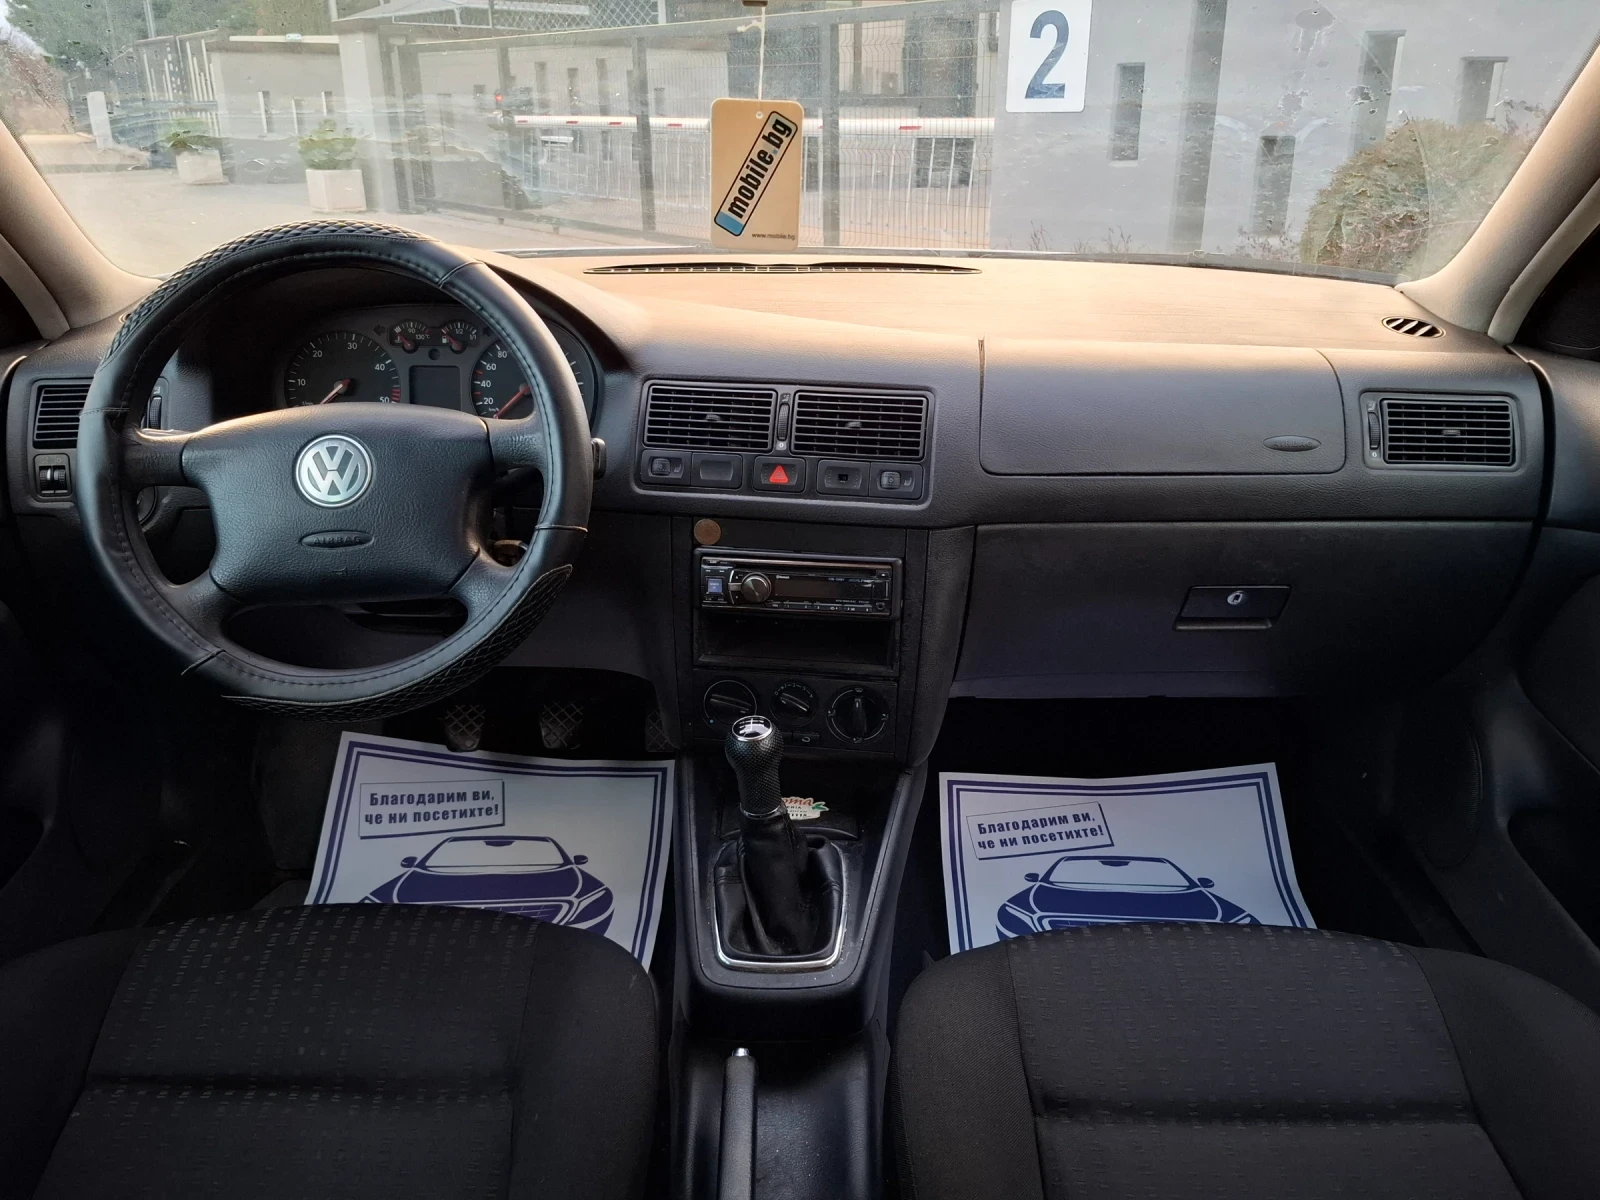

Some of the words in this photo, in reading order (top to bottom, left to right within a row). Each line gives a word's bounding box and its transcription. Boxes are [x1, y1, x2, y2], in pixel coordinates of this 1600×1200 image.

[1025, 10, 1069, 99] 2
[728, 118, 792, 219] mobile.bg
[752, 232, 796, 241] www.mobile.bg
[347, 342, 358, 350] 30
[312, 350, 323, 358] 20
[497, 350, 507, 358] 80
[374, 363, 385, 371] 40
[486, 363, 497, 371] 60
[297, 378, 306, 386] 10
[480, 380, 492, 388] 40
[483, 397, 494, 405] 20
[312, 535, 362, 545] AIRBAG
[369, 790, 467, 806] Благодарим
[472, 790, 495, 801] ви,
[364, 813, 383, 825] че
[388, 812, 407, 824] ни
[413, 804, 499, 823] посетихте!
[977, 813, 1069, 835] Благодарим
[1073, 812, 1096, 823] ви,
[978, 838, 995, 850] че
[999, 836, 1019, 848] ни
[1022, 824, 1104, 845] посетихте!
